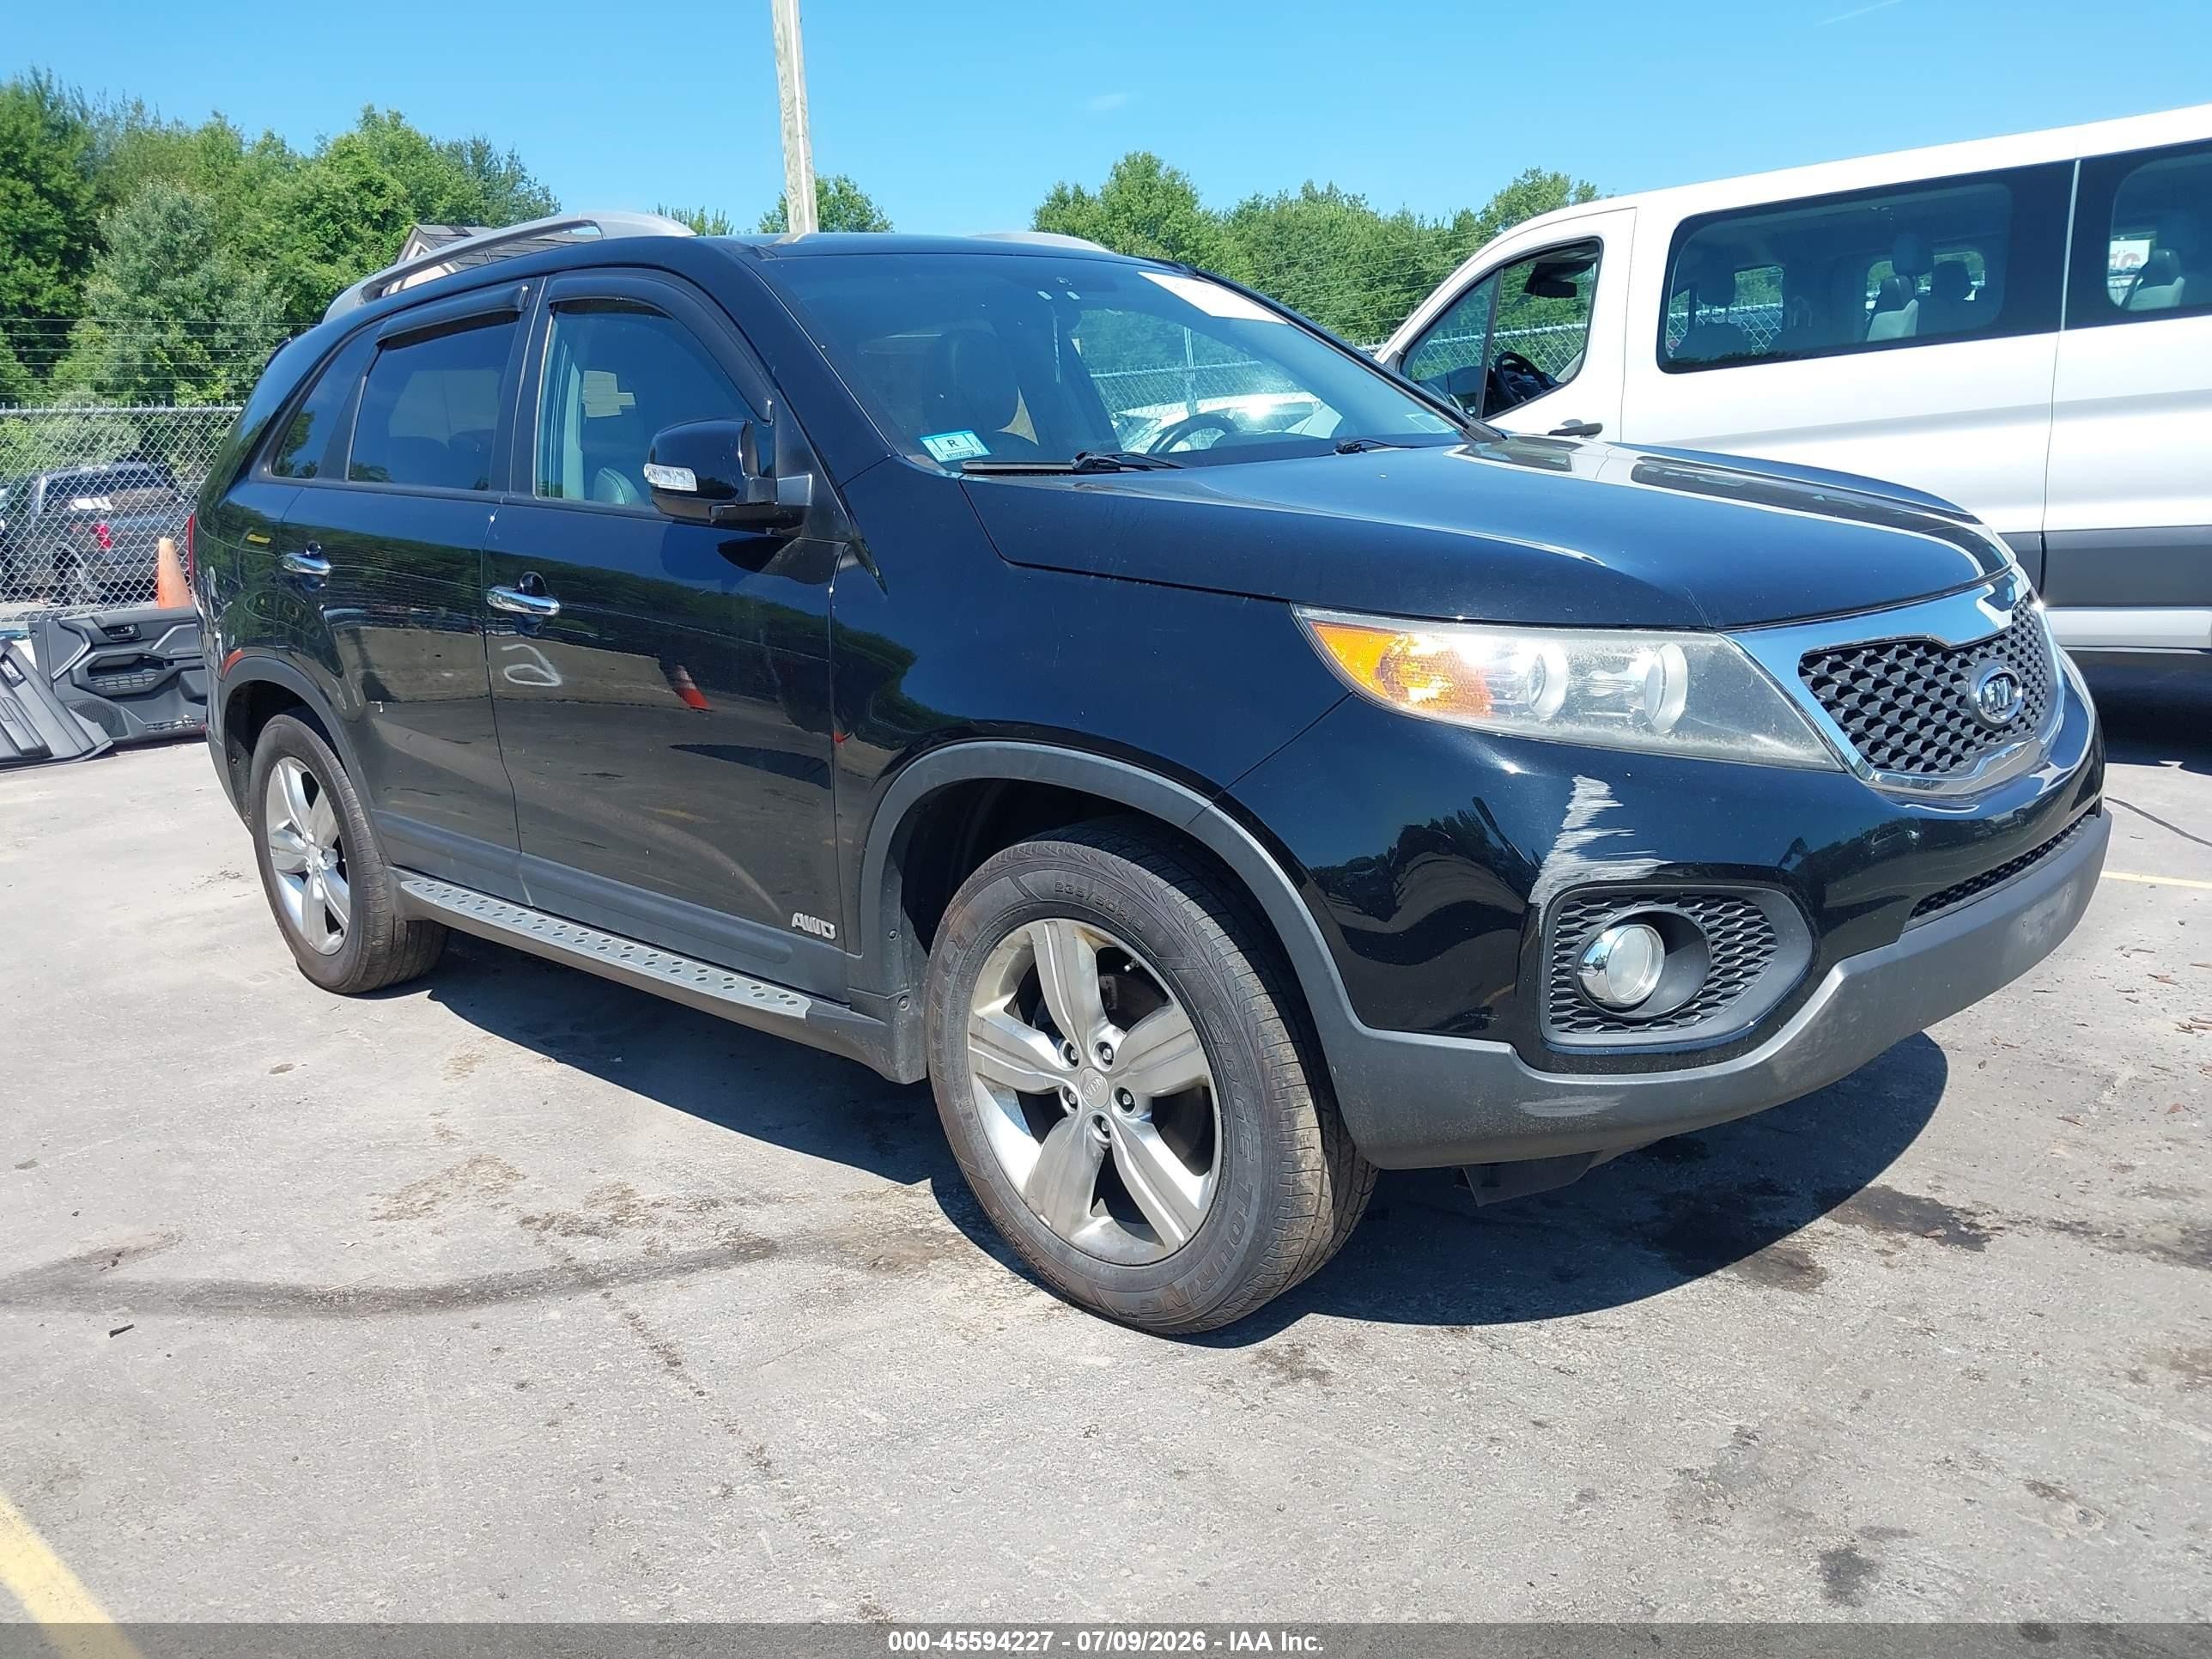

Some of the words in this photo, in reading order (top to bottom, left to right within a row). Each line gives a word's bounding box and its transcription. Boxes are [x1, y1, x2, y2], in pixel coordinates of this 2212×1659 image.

[946, 439, 960, 447] R
[501, 643, 562, 686] 2
[791, 912, 836, 939] AWD
[1203, 1010, 1255, 1162] EDGE
[1122, 1182, 1254, 1315] TOURING
